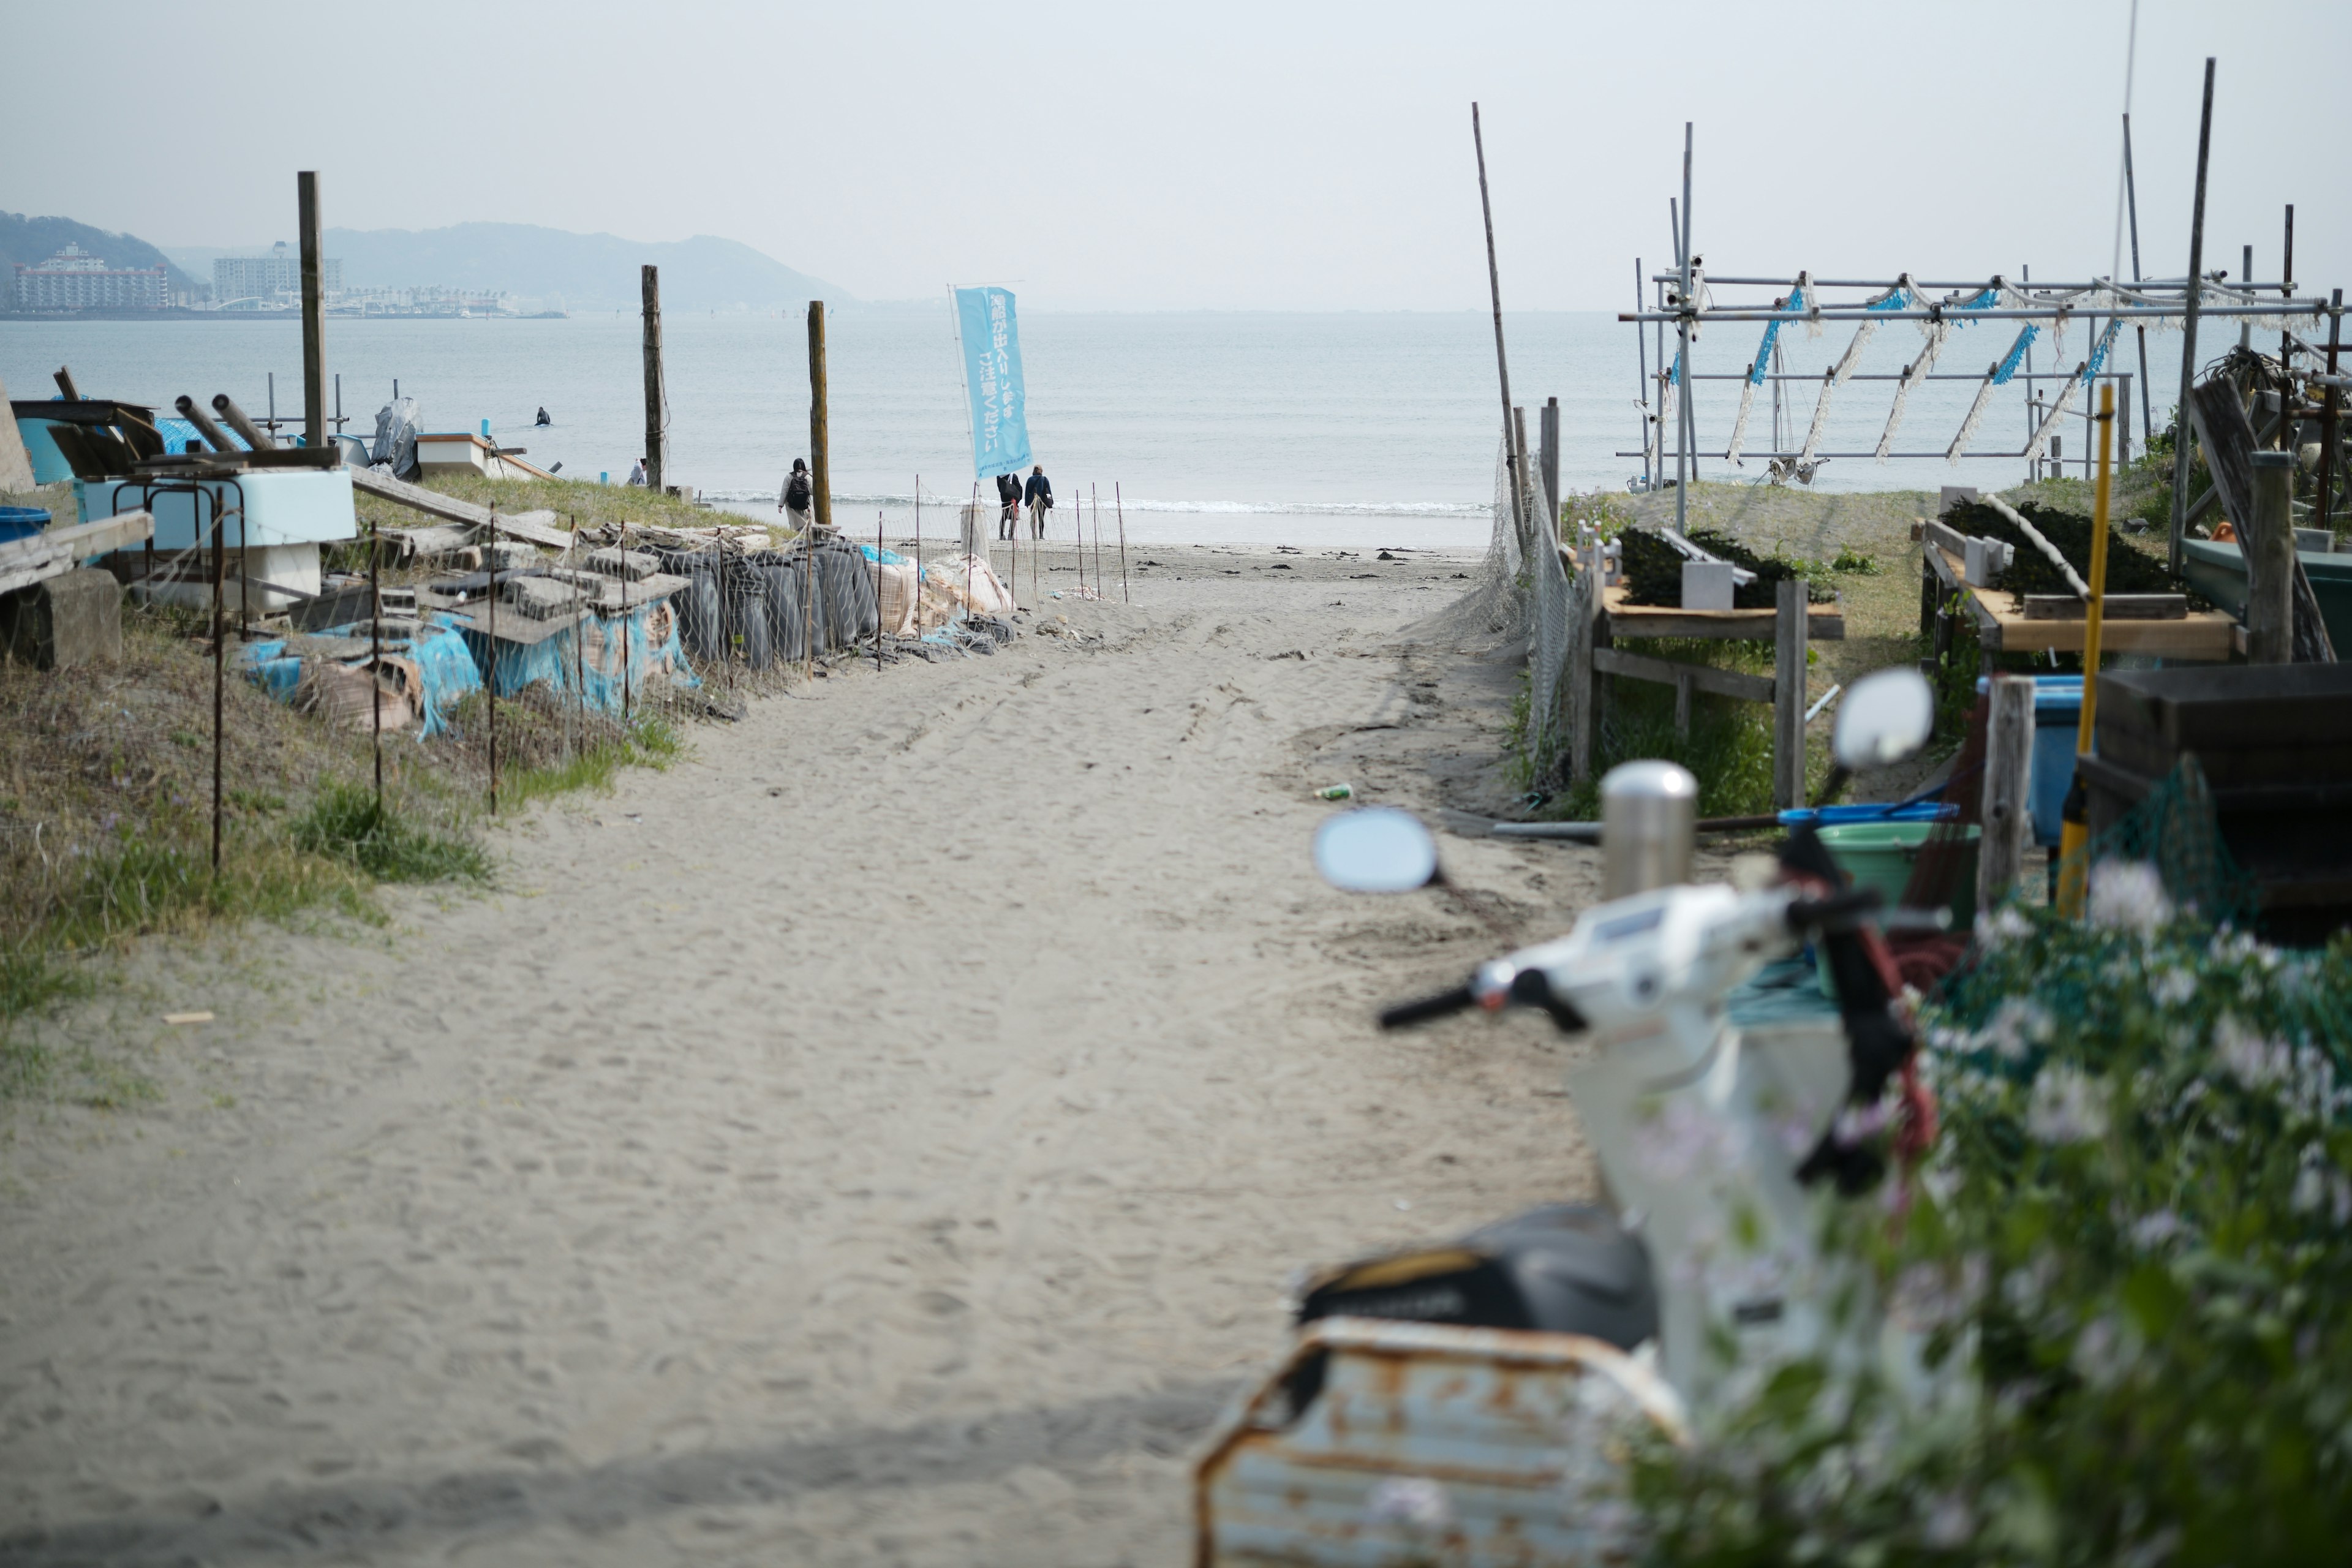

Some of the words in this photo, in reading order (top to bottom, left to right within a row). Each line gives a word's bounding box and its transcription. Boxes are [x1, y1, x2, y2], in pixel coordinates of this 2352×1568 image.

[979, 352, 1000, 452] ご注意ください
